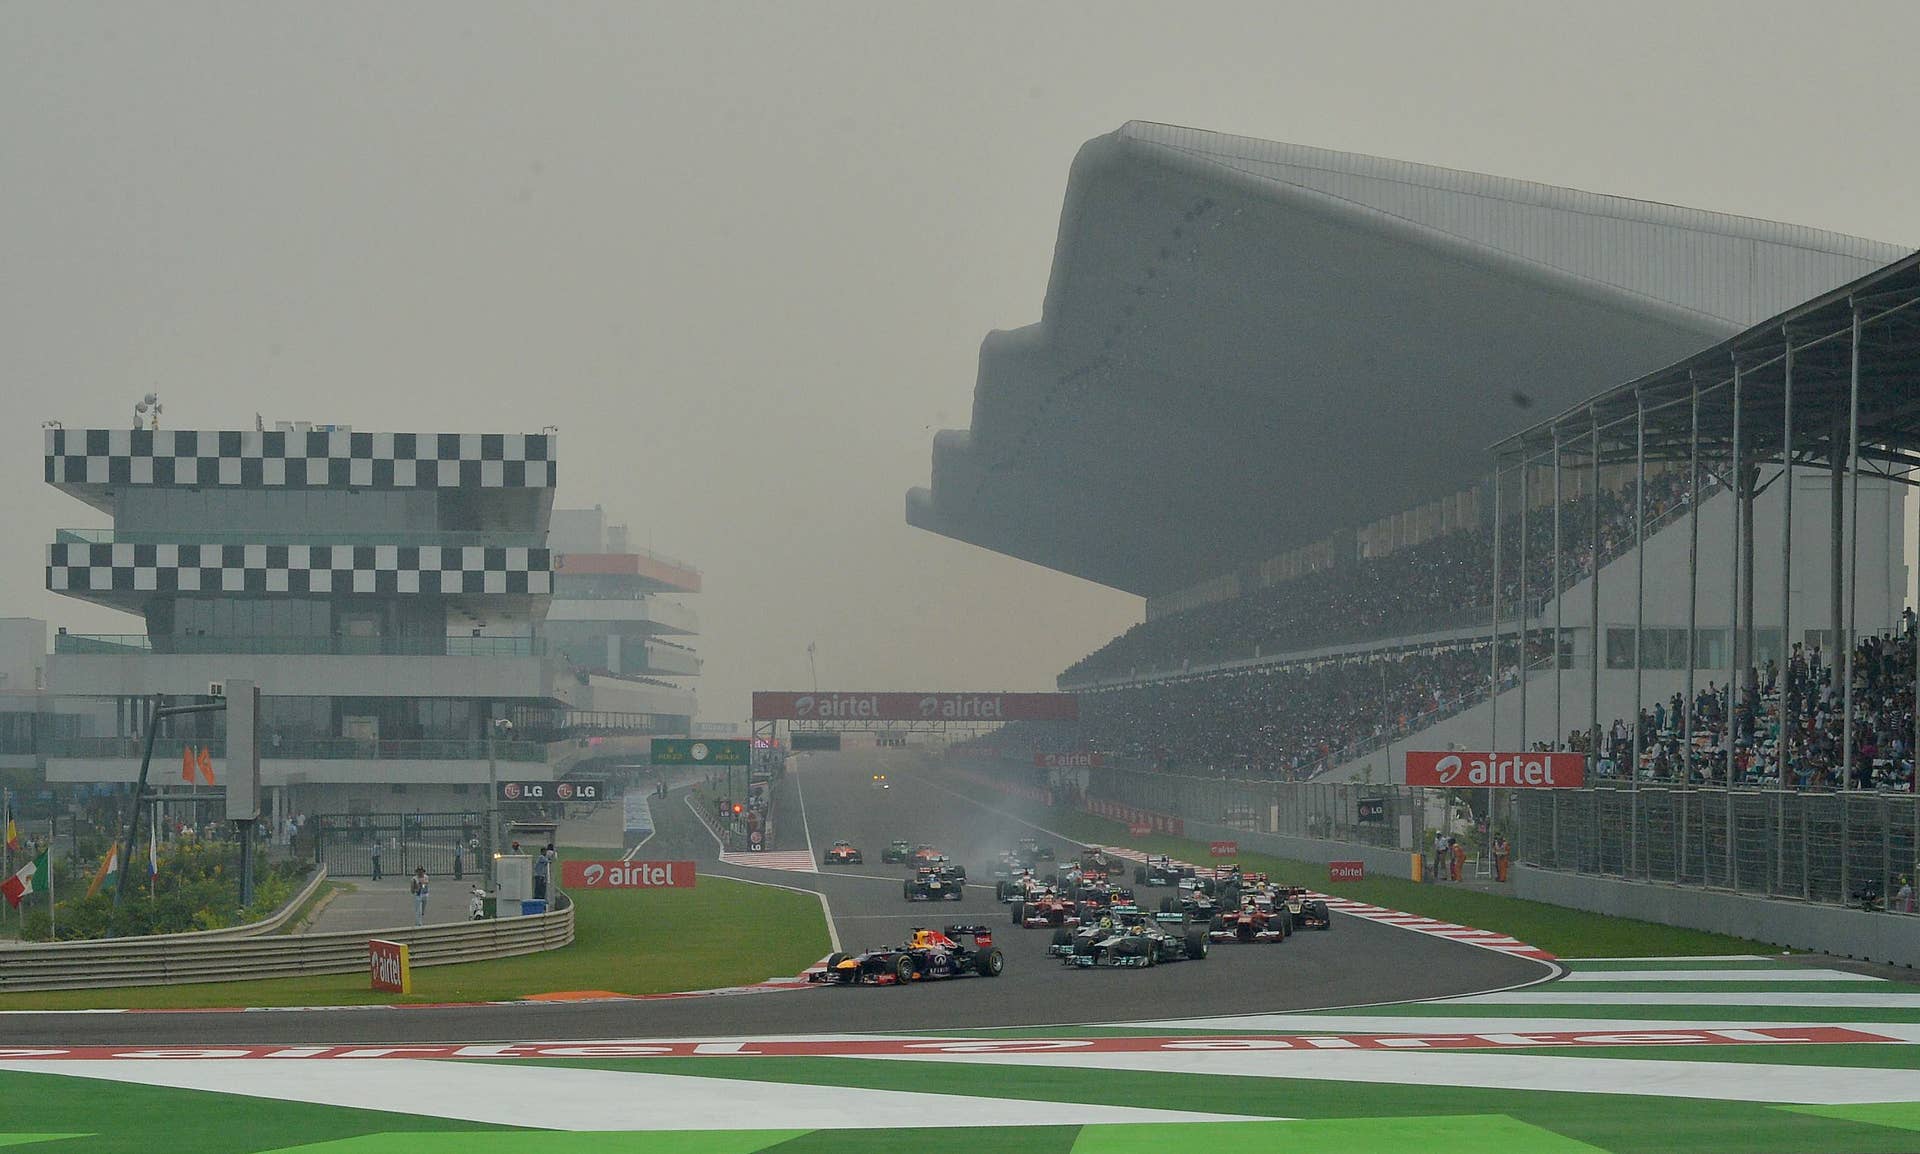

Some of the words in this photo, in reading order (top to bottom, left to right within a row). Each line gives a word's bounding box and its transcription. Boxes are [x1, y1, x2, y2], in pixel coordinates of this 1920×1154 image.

[818, 695, 880, 717] airtel
[942, 695, 1002, 717] airtel
[1057, 753, 1092, 767] airtel
[1468, 752, 1555, 785] airtel
[524, 785, 543, 797] LG
[576, 786, 595, 798] LG
[1371, 806, 1383, 815] LG
[608, 860, 675, 886] airtel
[1340, 865, 1363, 878] airtel
[379, 948, 402, 986] airtel
[1161, 1029, 1811, 1049] airtel
[111, 1042, 763, 1058] airtel
